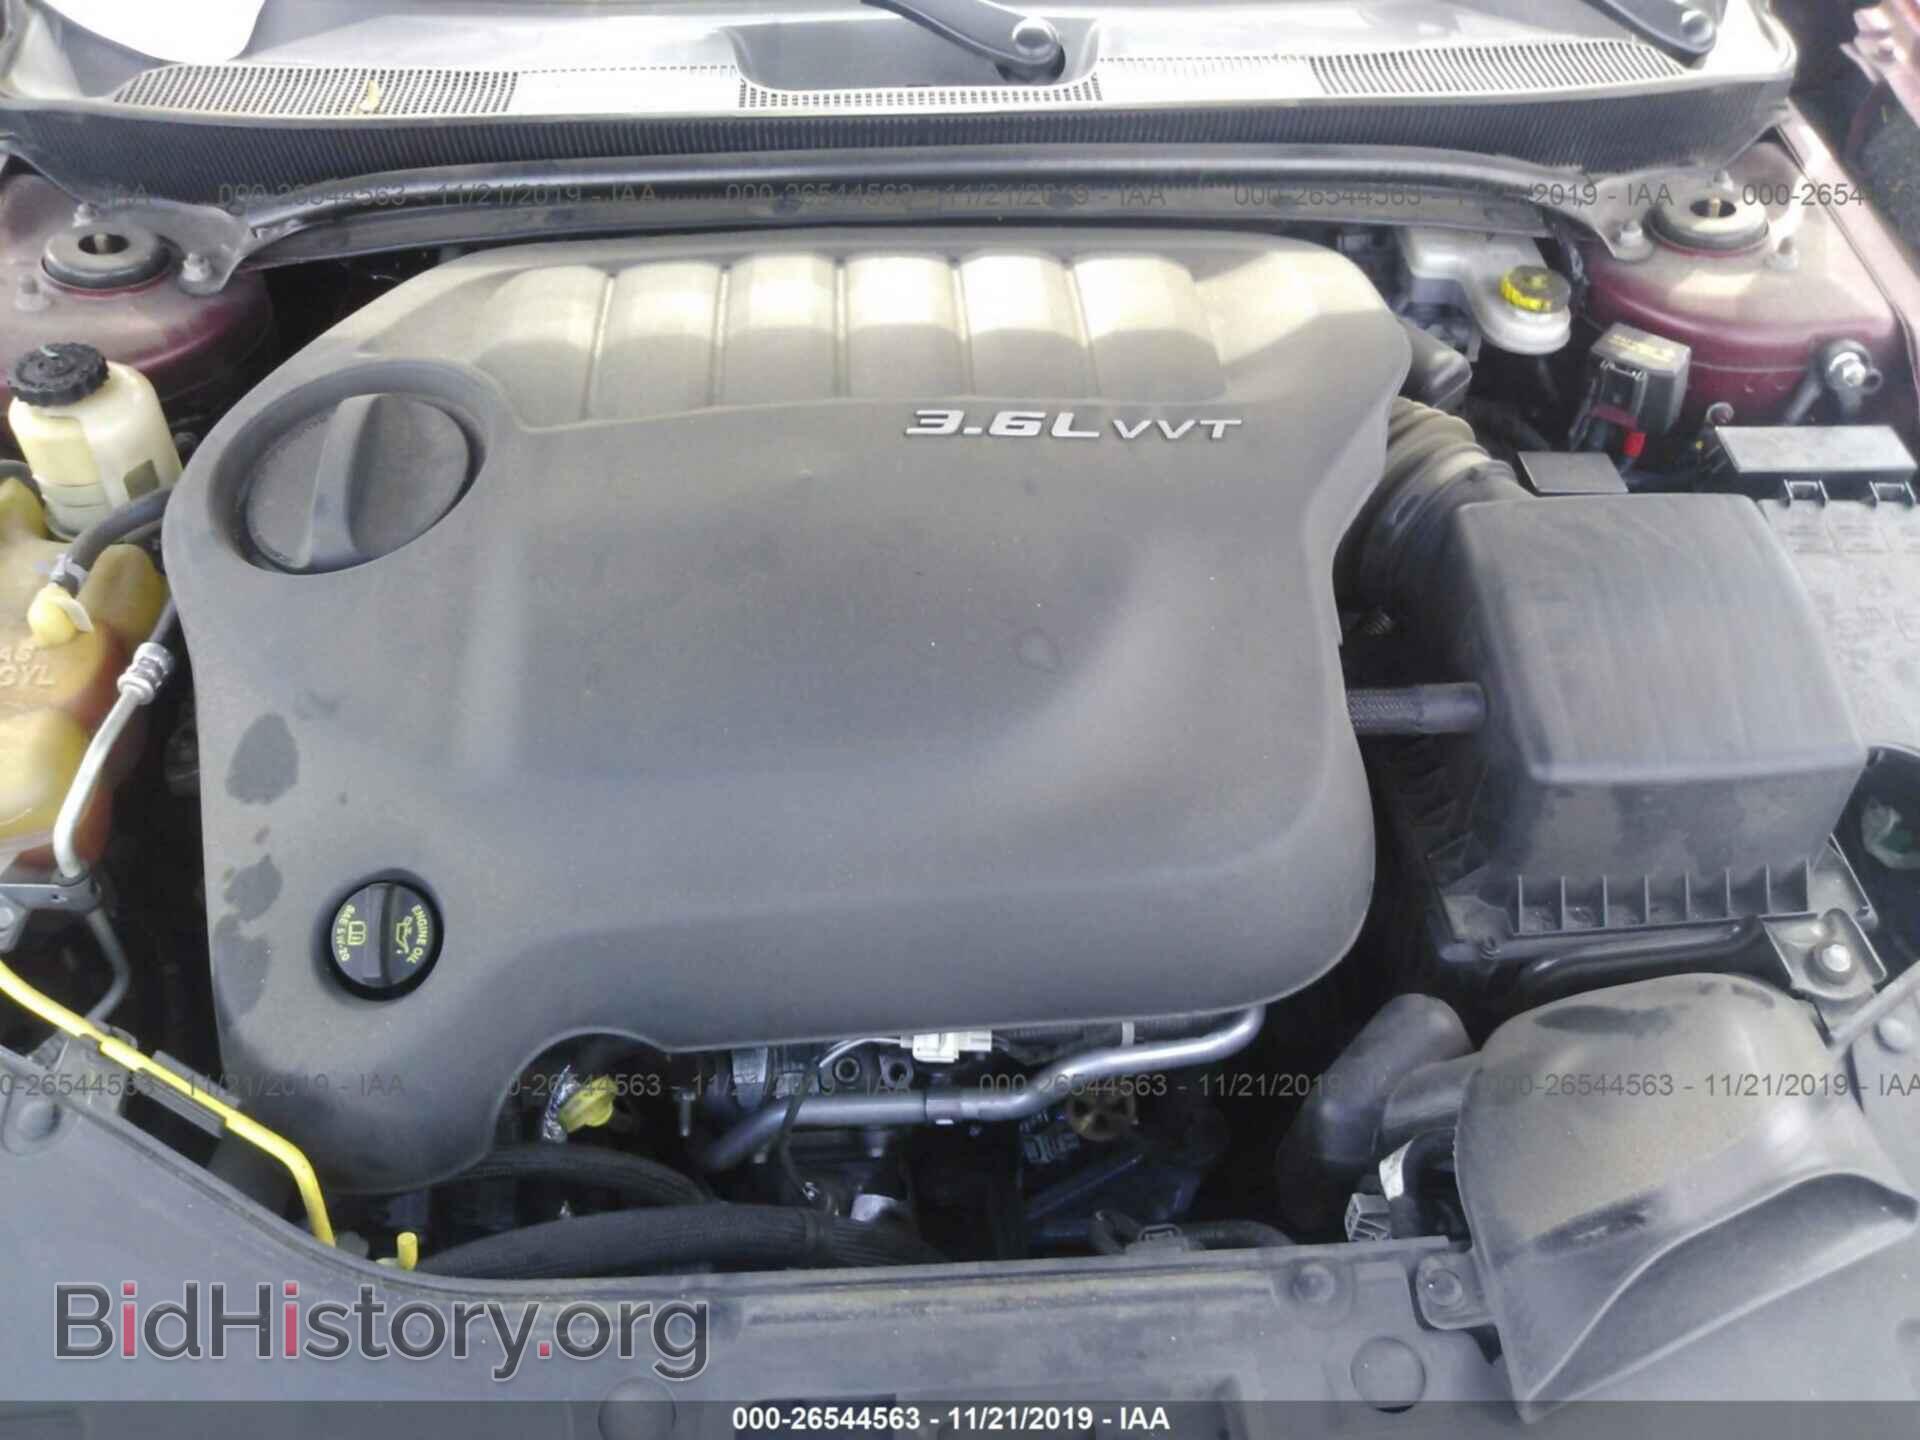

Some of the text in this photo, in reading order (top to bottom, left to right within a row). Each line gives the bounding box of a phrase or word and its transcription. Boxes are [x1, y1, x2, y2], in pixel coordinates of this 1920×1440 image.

[905, 409, 1244, 440] 3.6L VVT
[405, 903, 428, 964] ENGINE OIL
